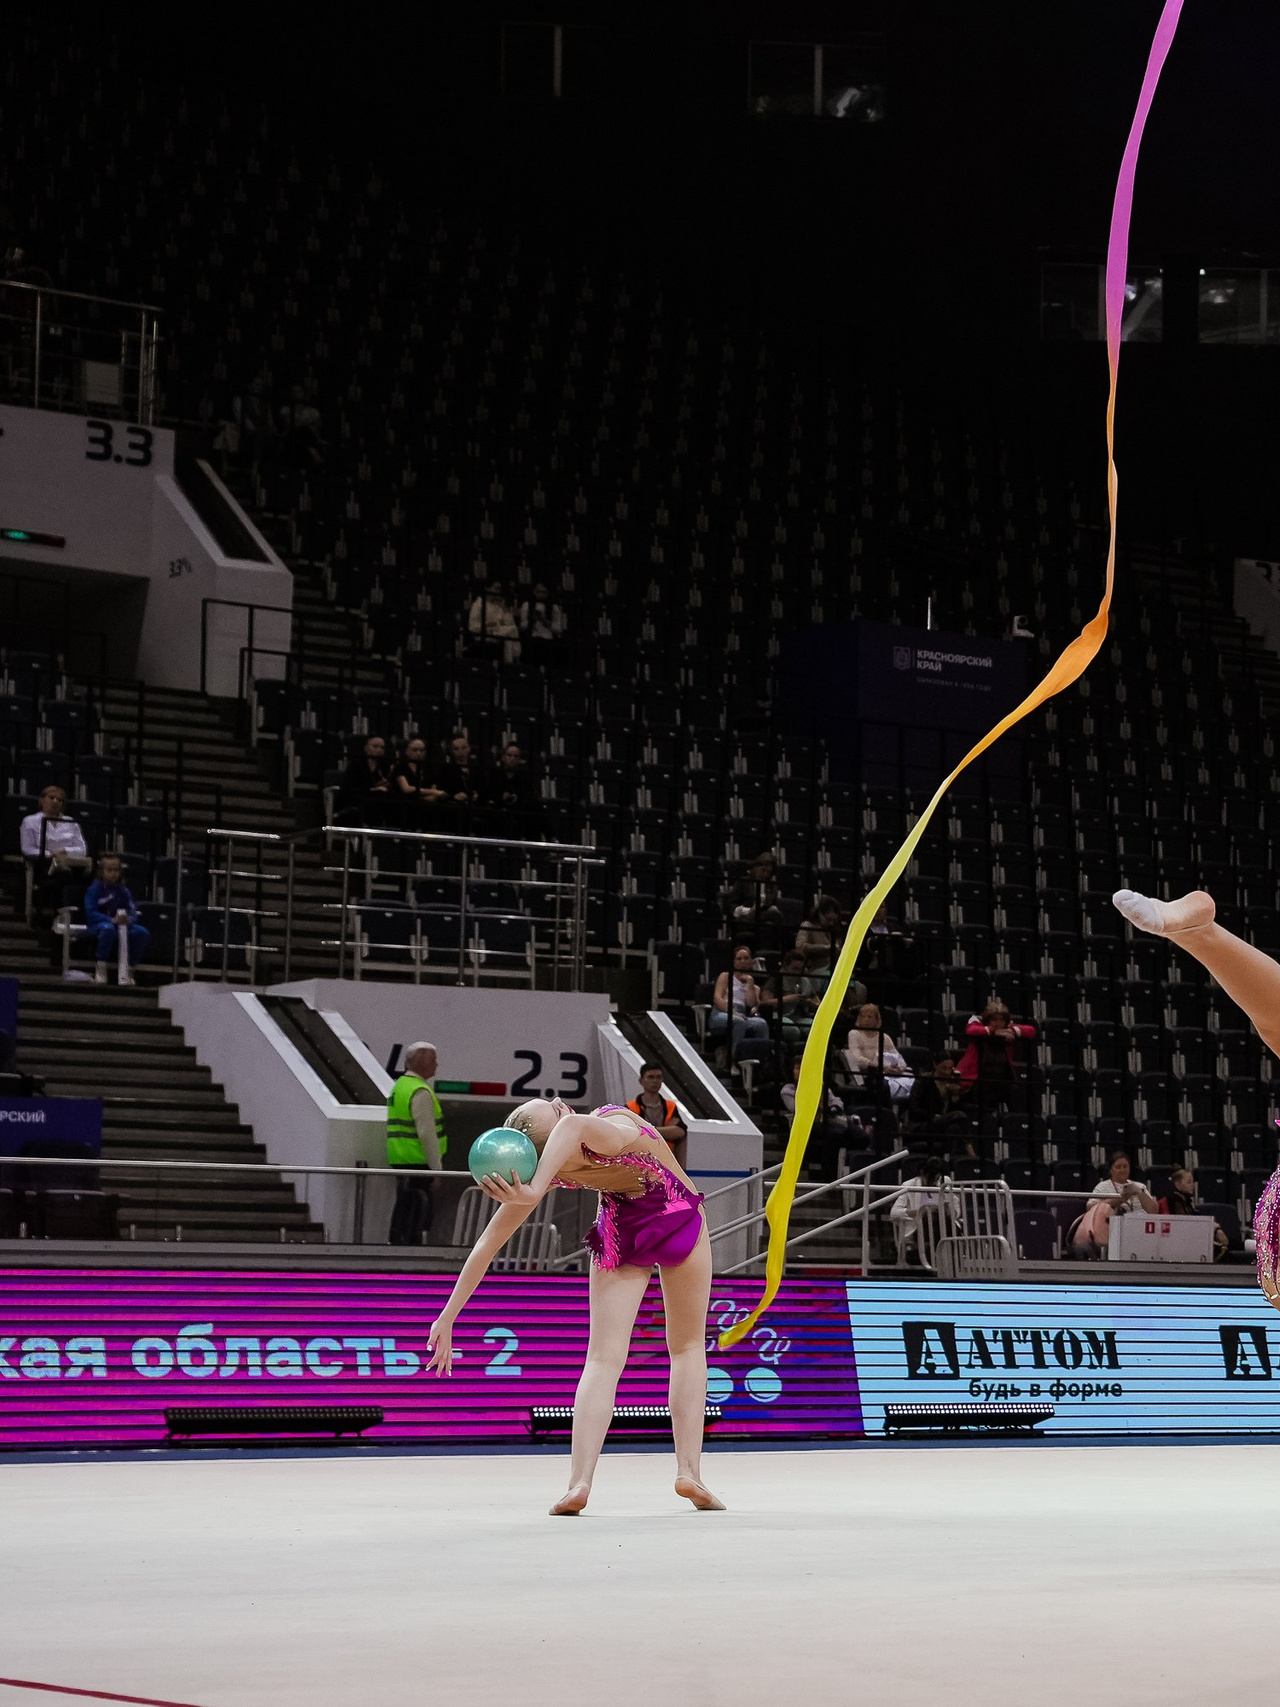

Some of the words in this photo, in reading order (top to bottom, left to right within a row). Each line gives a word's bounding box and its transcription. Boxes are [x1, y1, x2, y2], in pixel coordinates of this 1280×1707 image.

[86, 420, 152, 467] 3.3
[917, 649, 992, 668] КРАСНОЯРСКИЙ
[917, 660, 942, 672] КРАЙ
[511, 1050, 588, 1098] 2.3
[131, 1323, 421, 1378] область
[483, 1327, 523, 1376] 2
[968, 1378, 1021, 1401] будь
[1029, 1382, 1041, 1397] в
[1049, 1378, 1123, 1402] форме
